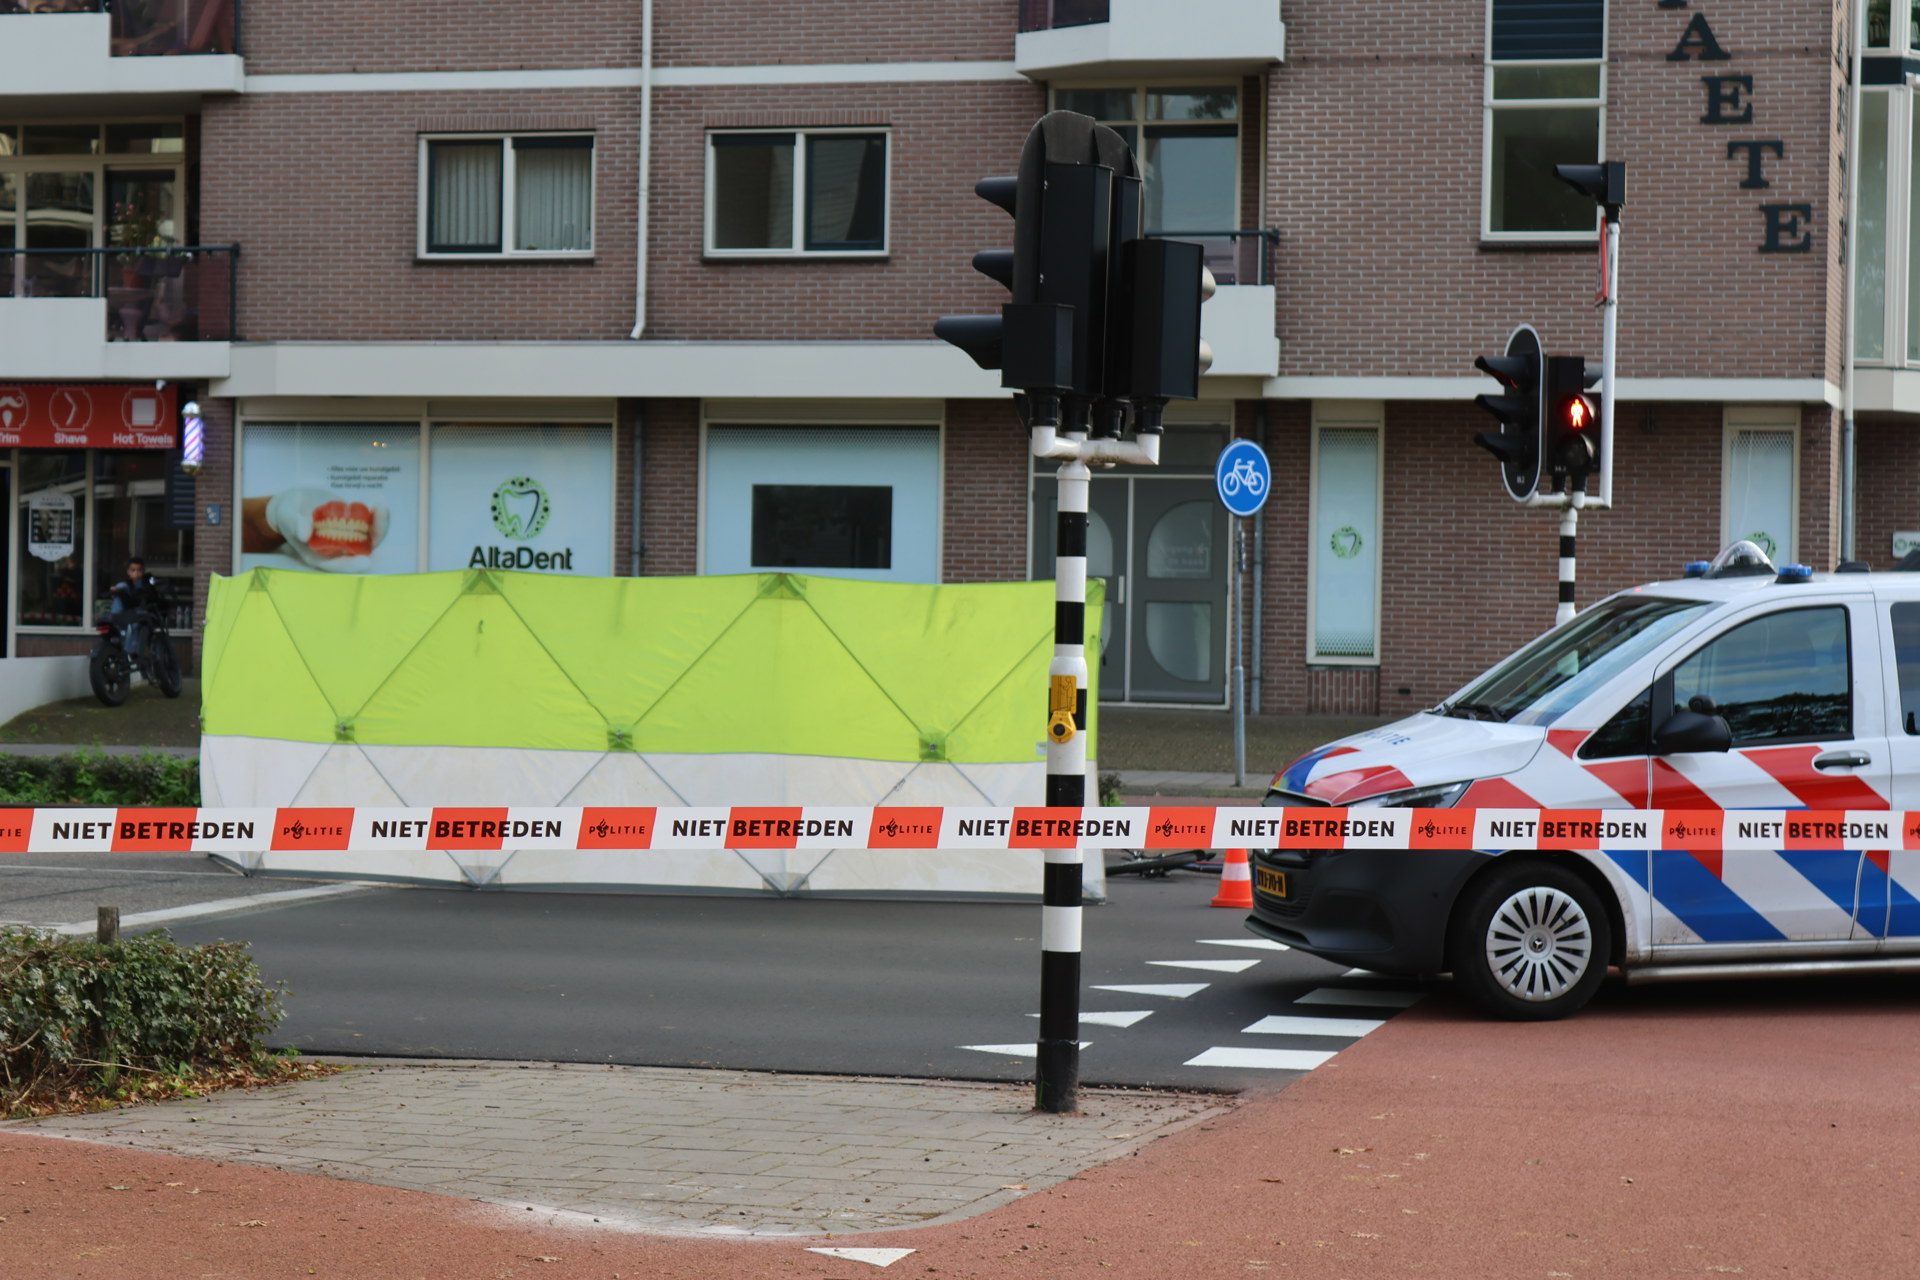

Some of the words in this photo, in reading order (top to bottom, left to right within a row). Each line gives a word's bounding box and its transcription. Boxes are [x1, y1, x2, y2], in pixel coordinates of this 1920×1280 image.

[53, 432, 88, 445] Shave
[112, 433, 134, 445] Hot
[136, 433, 174, 445] Towels
[469, 545, 574, 570] AltaDent
[52, 822, 112, 840] NIET
[120, 822, 255, 840] BETREDEN
[371, 821, 428, 838] NIET
[435, 820, 562, 840] BETREDEN
[673, 820, 727, 837] NIET
[733, 820, 854, 837] BETREDEN
[958, 820, 1010, 837] NIET
[1016, 820, 1131, 837] BETREDEN
[1230, 820, 1280, 837] NIET
[1285, 820, 1395, 837] BETREDEN
[1490, 821, 1537, 838] NIET
[1542, 821, 1647, 839] BETREDEN
[1738, 822, 1783, 839] NIET
[1789, 822, 1888, 839] BETREDEN
